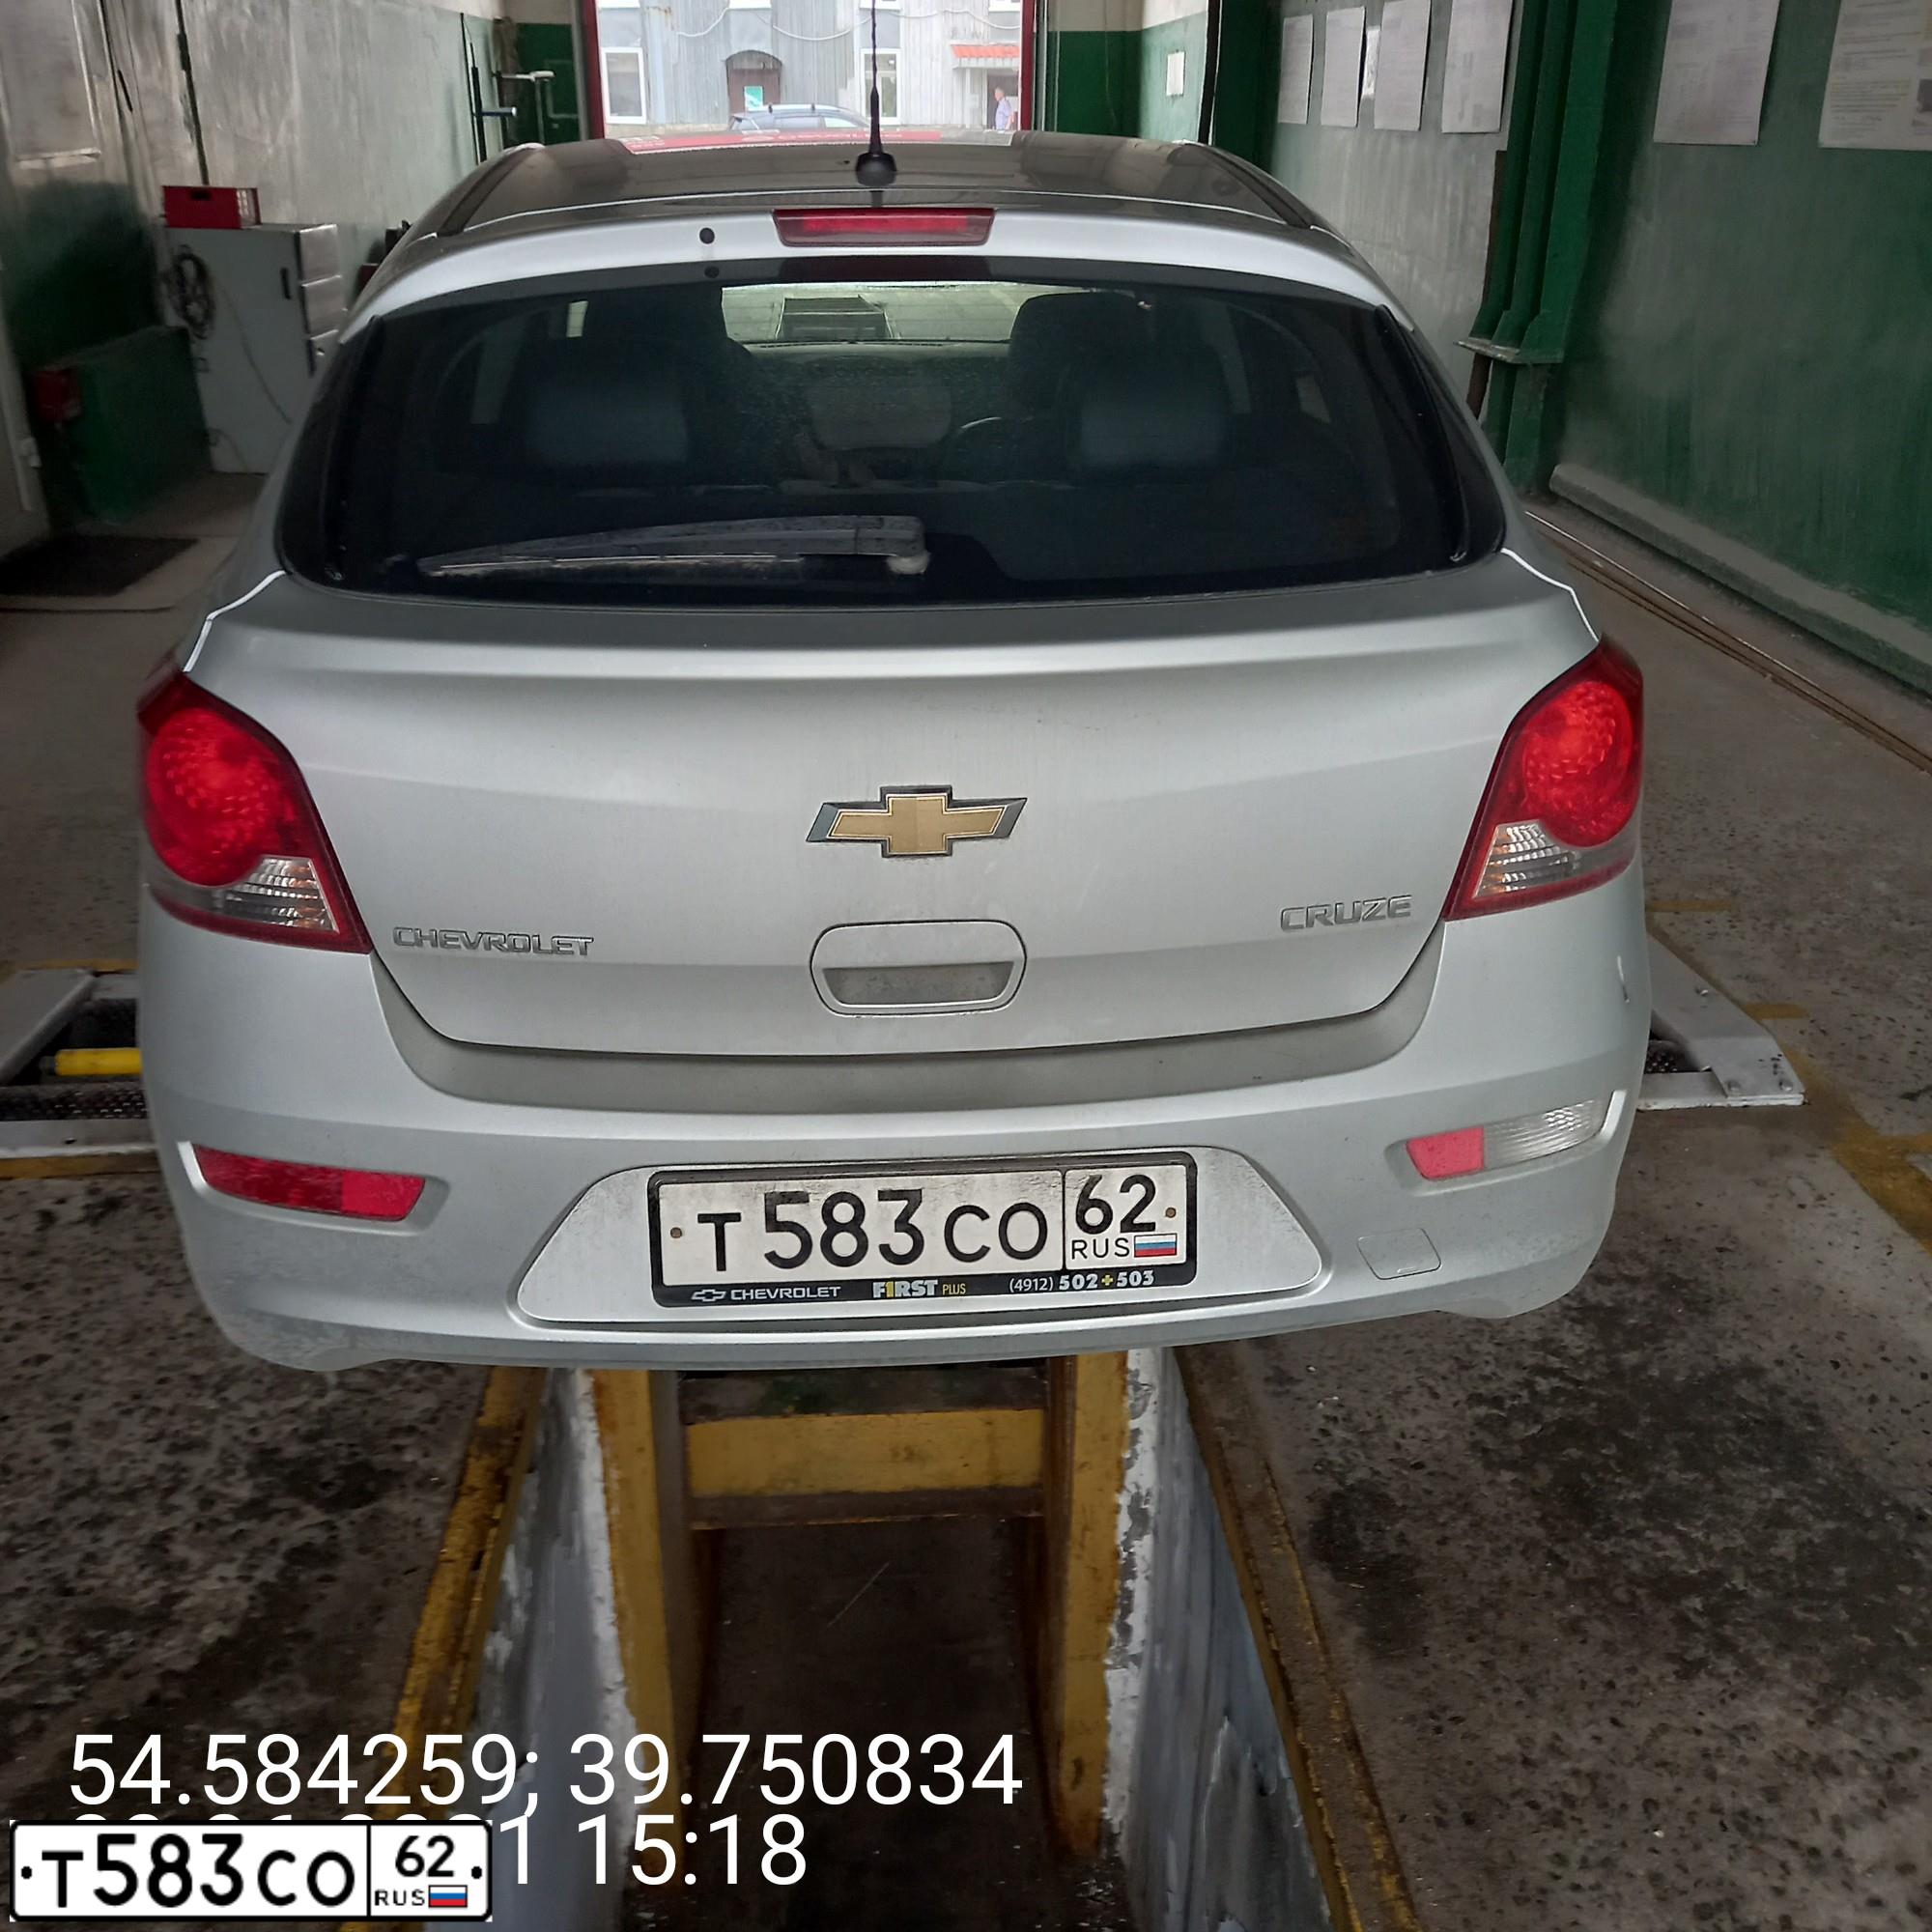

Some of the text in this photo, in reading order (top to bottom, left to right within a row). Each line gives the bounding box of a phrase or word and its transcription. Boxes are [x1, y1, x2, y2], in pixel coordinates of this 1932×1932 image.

[1280, 895, 1412, 930] CRUZE
[392, 926, 594, 955] CHEVROLET
[1075, 1174, 1157, 1234] 62
[1071, 1237, 1130, 1261] RUS
[730, 1286, 841, 1300] CHEVROLET
[942, 1282, 966, 1295] PLUS
[1009, 1276, 1055, 1293] (4912)
